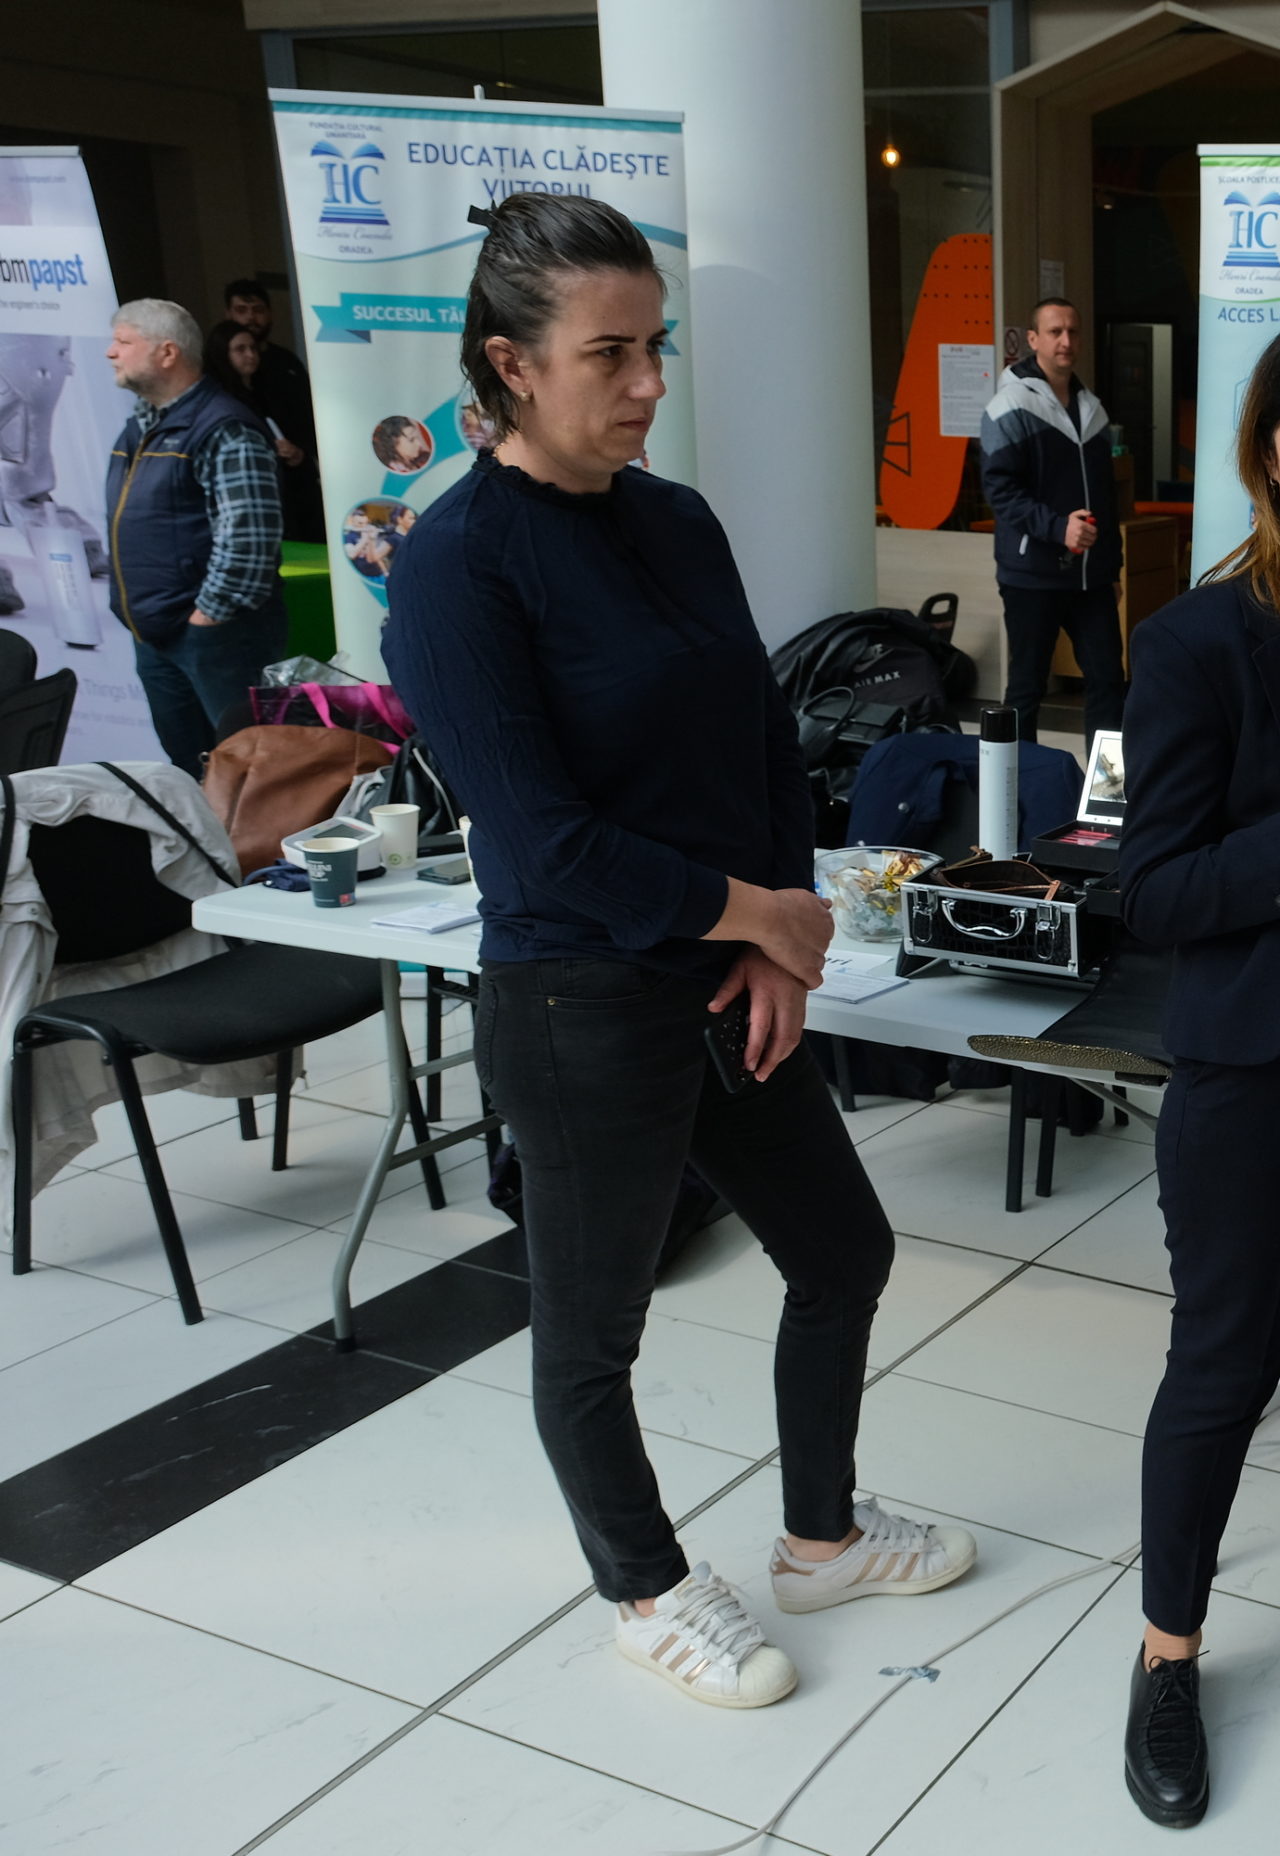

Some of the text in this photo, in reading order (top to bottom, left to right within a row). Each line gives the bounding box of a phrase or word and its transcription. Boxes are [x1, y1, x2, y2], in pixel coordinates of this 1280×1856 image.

[352, 305, 436, 323] SUCCESUL
[1217, 307, 1264, 323] ACCES
[874, 670, 901, 684] MAX
